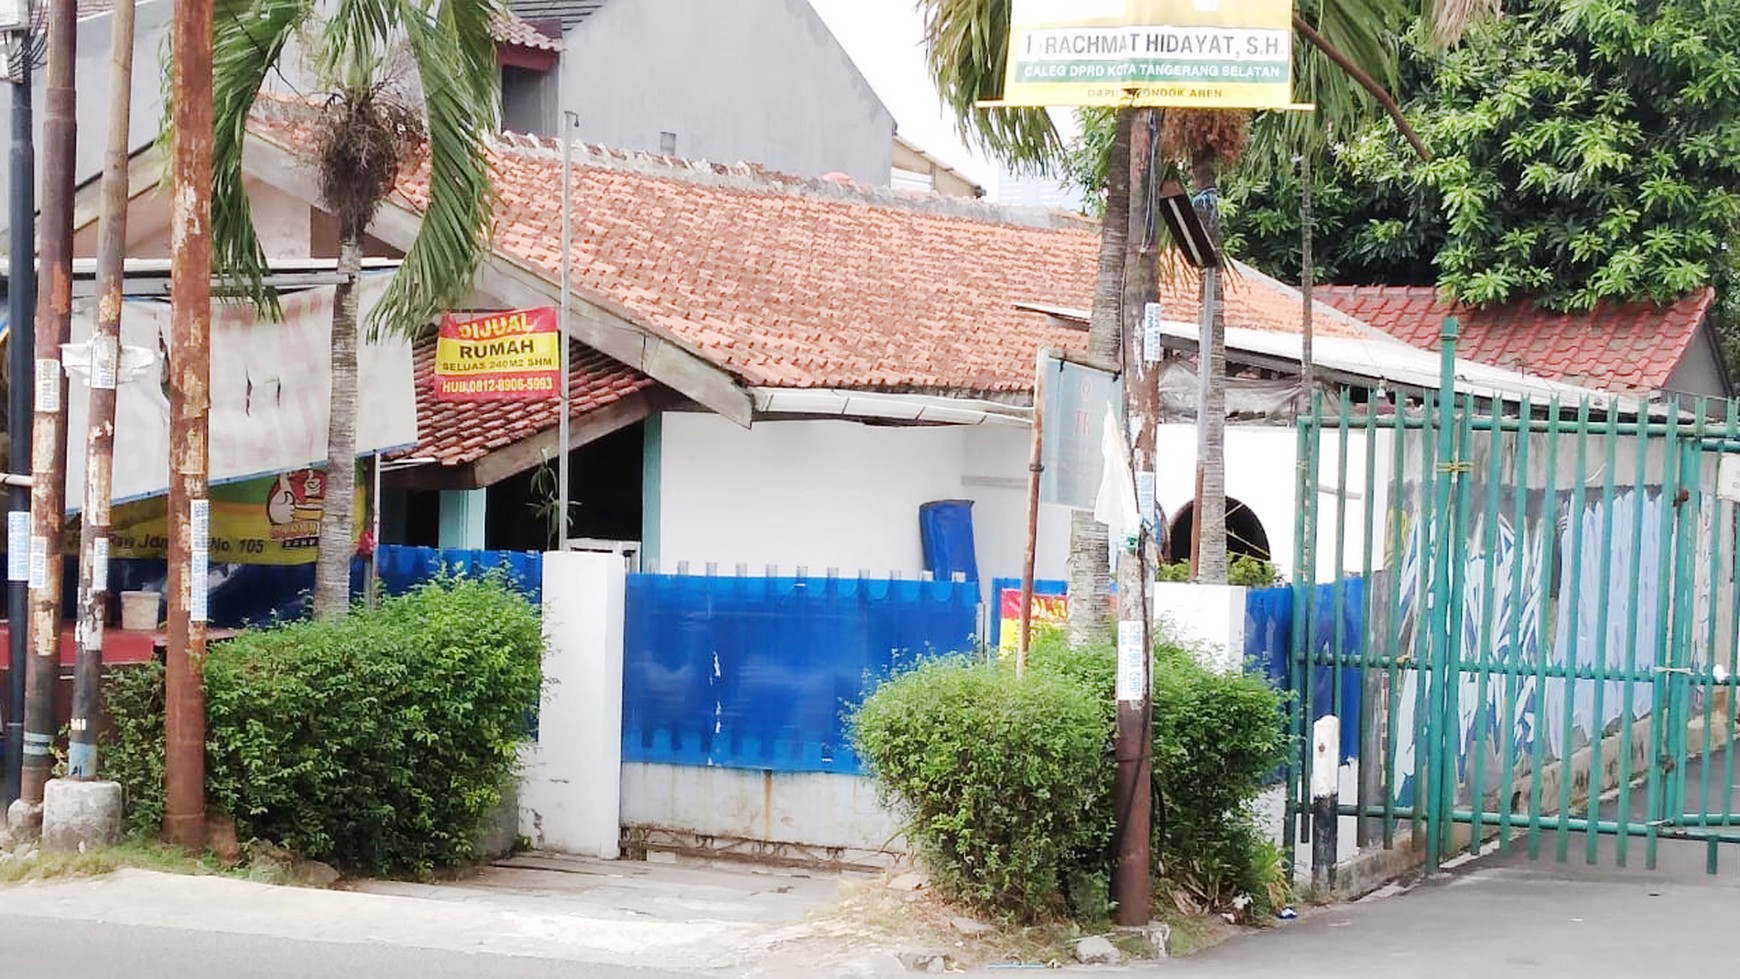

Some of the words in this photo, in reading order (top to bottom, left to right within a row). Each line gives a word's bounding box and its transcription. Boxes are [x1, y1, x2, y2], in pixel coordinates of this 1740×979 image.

[1044, 33, 1141, 54] RACHMAT
[1024, 65, 1067, 78] CALEG
[1069, 65, 1105, 77] DPRD
[1107, 63, 1137, 77] KOTA
[1139, 63, 1220, 77] TANGERANG
[1221, 65, 1281, 78] SELATAN
[1137, 87, 1185, 98] ONDOK
[458, 313, 535, 339] DIJUAL
[459, 340, 535, 359] RUMAH
[442, 361, 486, 372] SELUAS
[527, 358, 552, 367] SHM
[240, 538, 264, 554] 105
